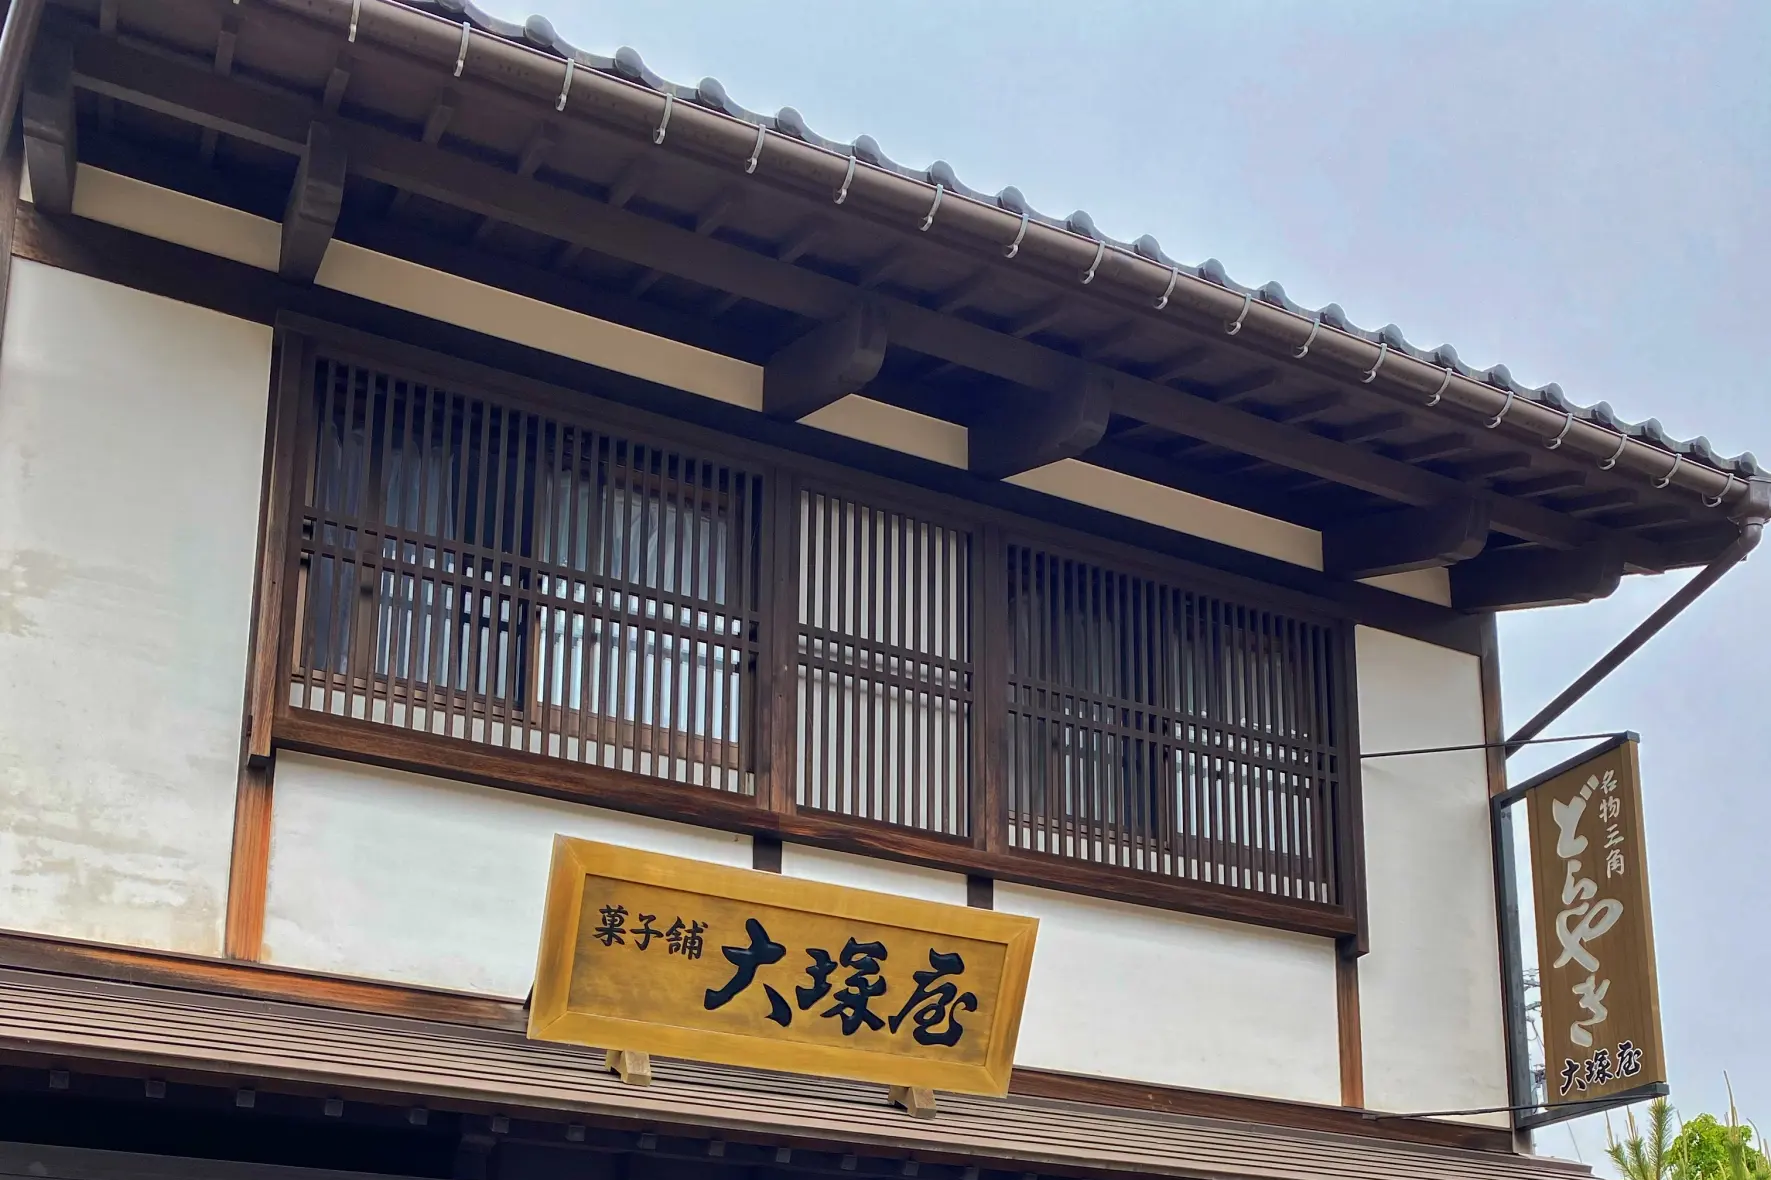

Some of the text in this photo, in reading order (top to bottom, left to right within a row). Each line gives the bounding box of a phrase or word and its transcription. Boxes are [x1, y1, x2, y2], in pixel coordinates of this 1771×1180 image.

[1599, 768, 1626, 879] 名物三角
[594, 905, 708, 960] 菓子舗
[1551, 774, 1625, 1048] どらやき
[704, 918, 978, 1046] 大塚屋
[1560, 1040, 1643, 1097] 大塚屋
